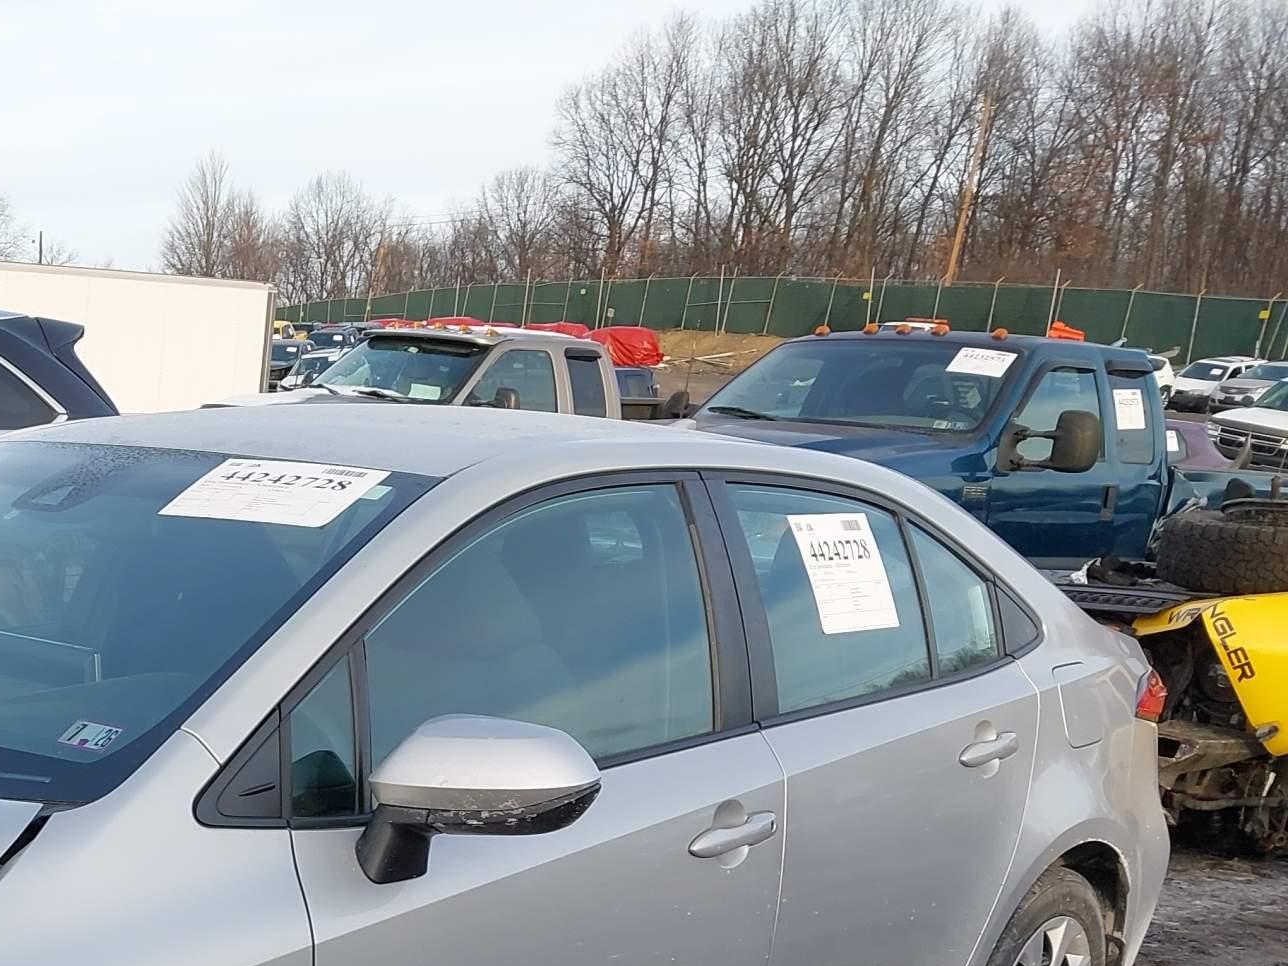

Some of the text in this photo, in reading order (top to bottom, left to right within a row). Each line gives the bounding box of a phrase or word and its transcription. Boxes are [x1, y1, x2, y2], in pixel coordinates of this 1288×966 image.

[221, 470, 353, 492] 44242728
[809, 539, 871, 561] 44242728
[66, 723, 120, 747] 7 26
